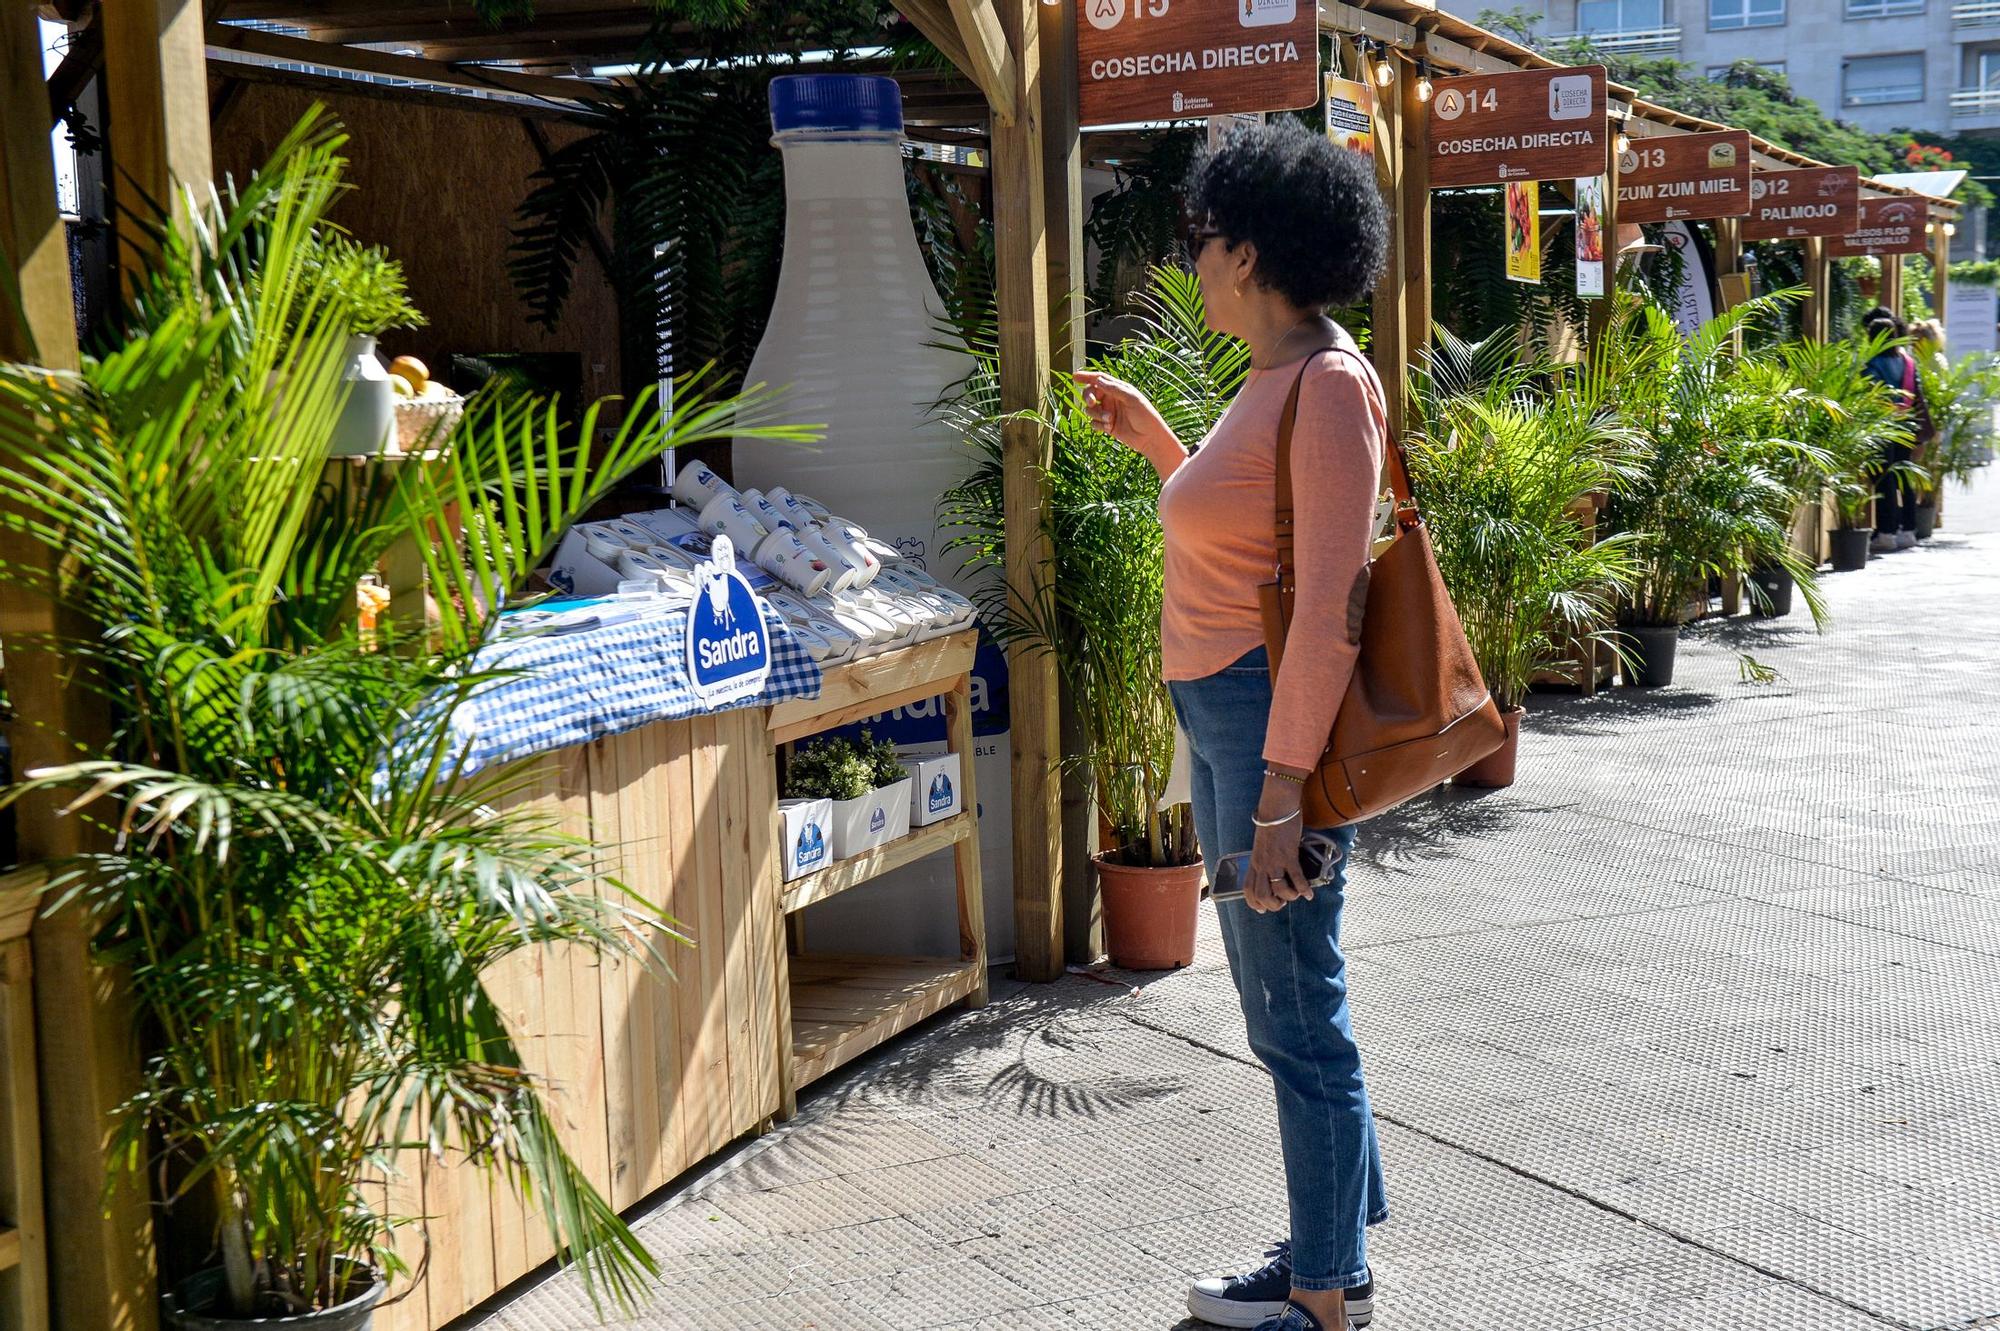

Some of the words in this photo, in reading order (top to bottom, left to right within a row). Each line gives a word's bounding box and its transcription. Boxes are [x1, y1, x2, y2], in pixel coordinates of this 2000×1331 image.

[1091, 51, 1197, 80] COSECHA
[1203, 41, 1299, 69] DIRECTA
[1466, 87, 1498, 113] 14
[1438, 136, 1518, 155] COSECHA
[1521, 130, 1594, 149] DIRECTA
[1640, 148, 1666, 168] 13
[1618, 185, 1654, 201] ZUM
[1657, 181, 1695, 198] ZUM
[1700, 178, 1741, 194] MIEL
[1767, 179, 1790, 195] 12
[1761, 203, 1837, 221] PALMOJO
[1884, 226, 1911, 236] FLOR
[699, 628, 760, 669] Sandra
[930, 795, 951, 810] Sandra
[798, 846, 822, 865] Sandra
